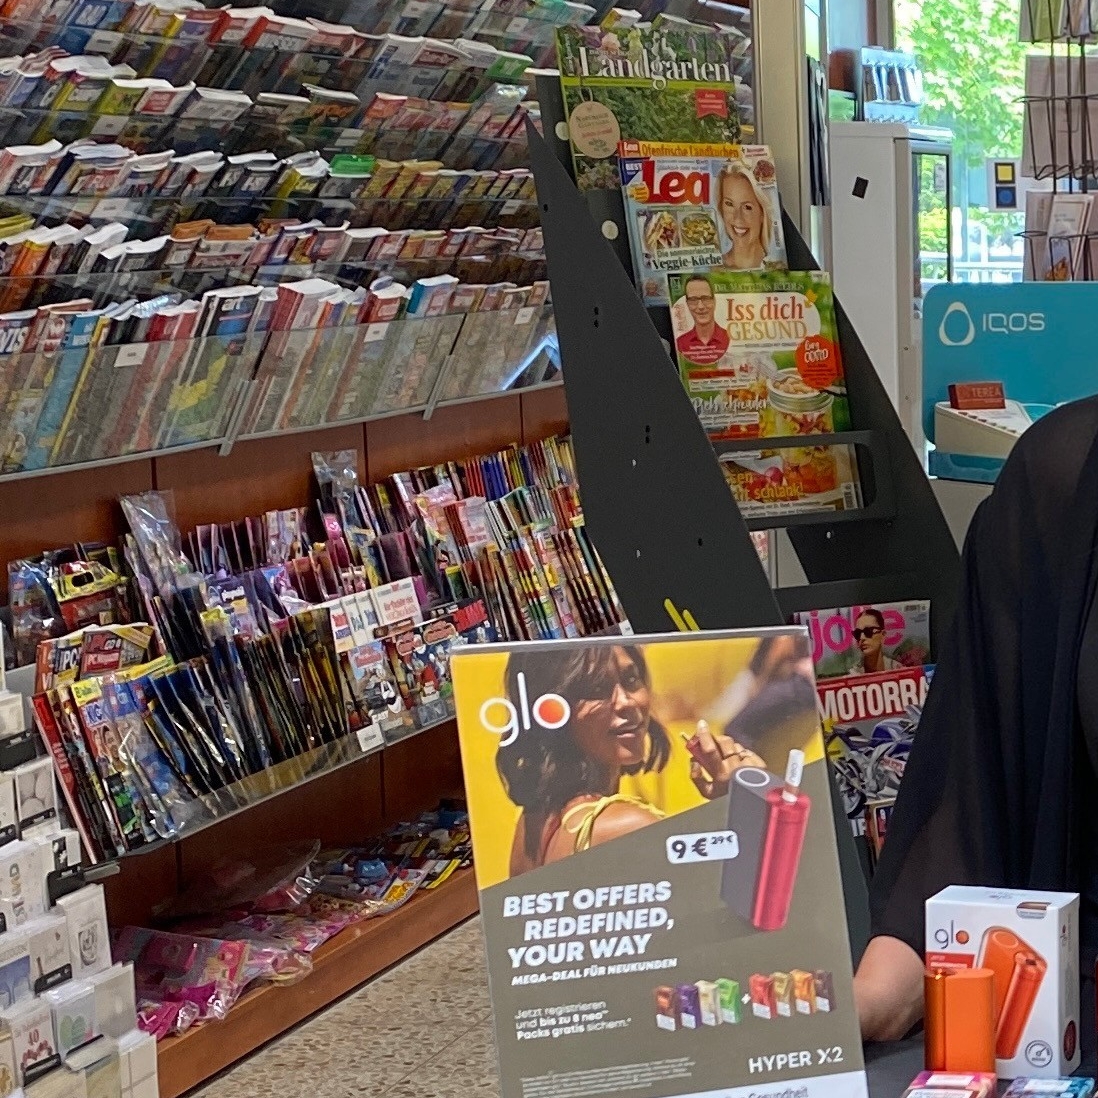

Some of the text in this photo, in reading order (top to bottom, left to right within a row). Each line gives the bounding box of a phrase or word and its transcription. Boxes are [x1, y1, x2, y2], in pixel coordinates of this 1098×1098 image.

[579, 47, 732, 90] Landgarten
[642, 160, 710, 205] Lea
[652, 254, 722, 270] Veggie-Küche
[726, 295, 804, 322] Iss dich
[727, 320, 808, 341] GESUND
[983, 312, 1045, 334] IQOS
[811, 606, 906, 664] joe
[479, 672, 571, 747] glo
[671, 840, 687, 859] 9
[503, 881, 672, 917] BEST OFFERS
[524, 907, 675, 941] REDEFINED,
[934, 920, 970, 949] glo
[508, 933, 652, 968] YOUR WAY
[511, 958, 678, 986] MEGA-DEAL FÜR NEUKUNDEN
[516, 1019, 537, 1029] und
[539, 1016, 556, 1027] bis
[516, 1027, 550, 1040] Packs
[551, 1024, 585, 1038] gratis
[749, 1046, 844, 1074] HYPER X2
